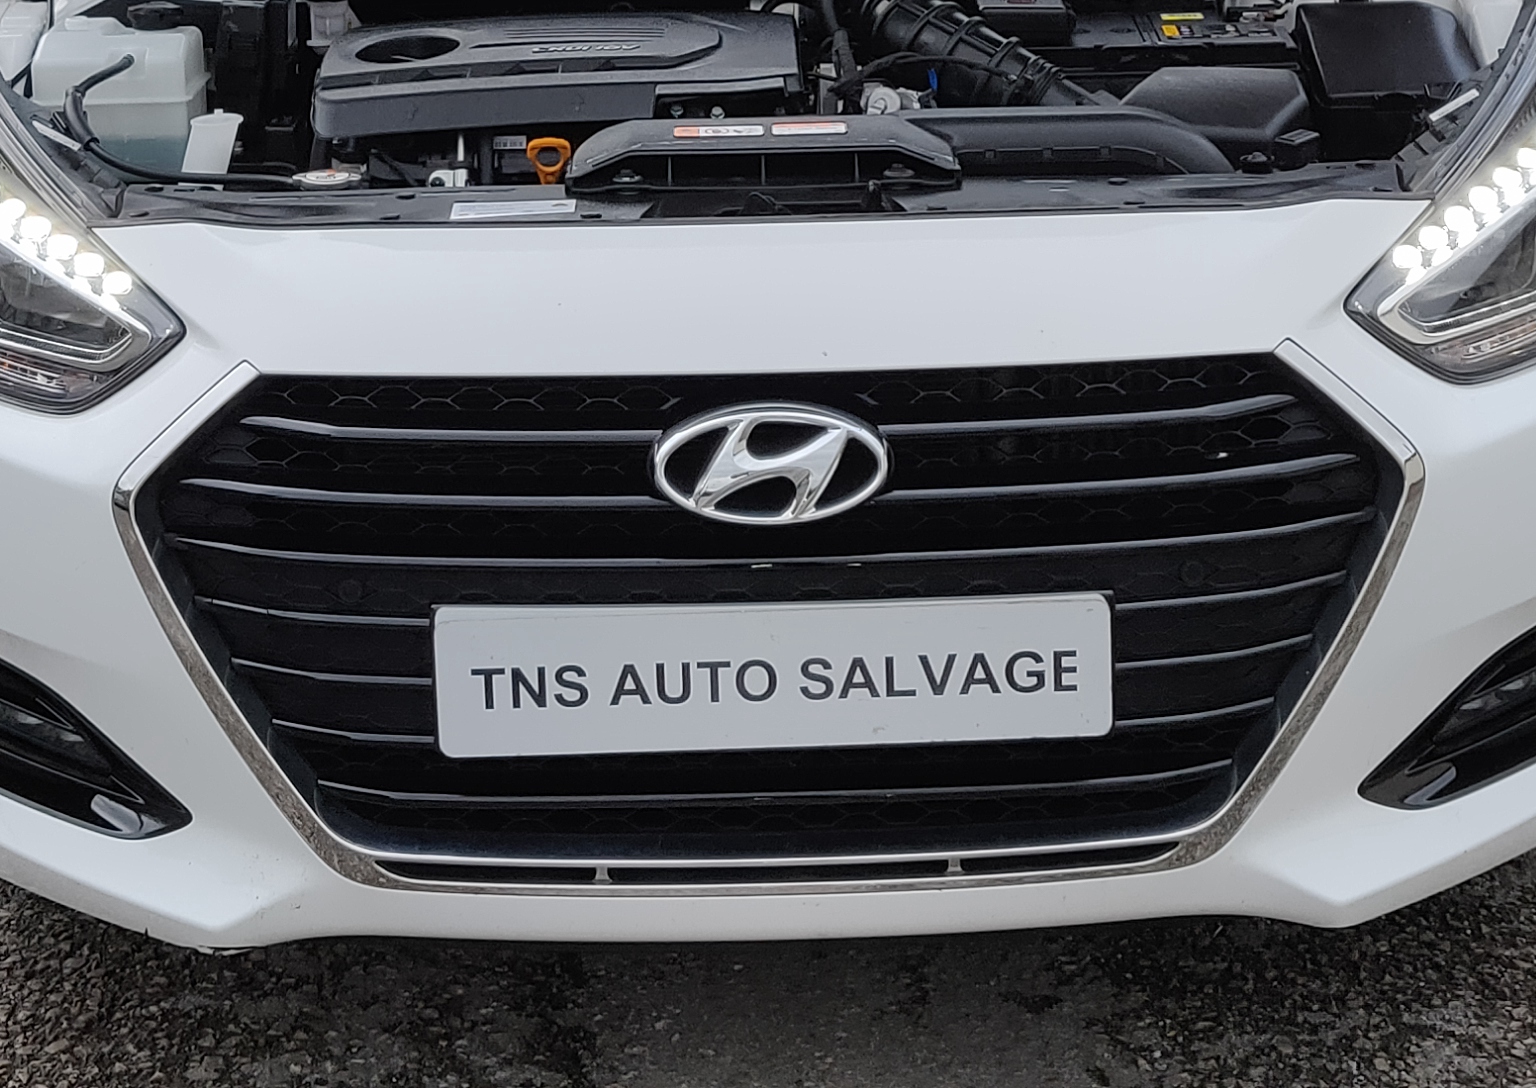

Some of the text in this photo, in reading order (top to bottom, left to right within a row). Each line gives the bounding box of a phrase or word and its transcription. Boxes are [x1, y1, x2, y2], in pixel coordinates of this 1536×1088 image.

[470, 649, 1079, 711] TNS AUTO SALVAGE
